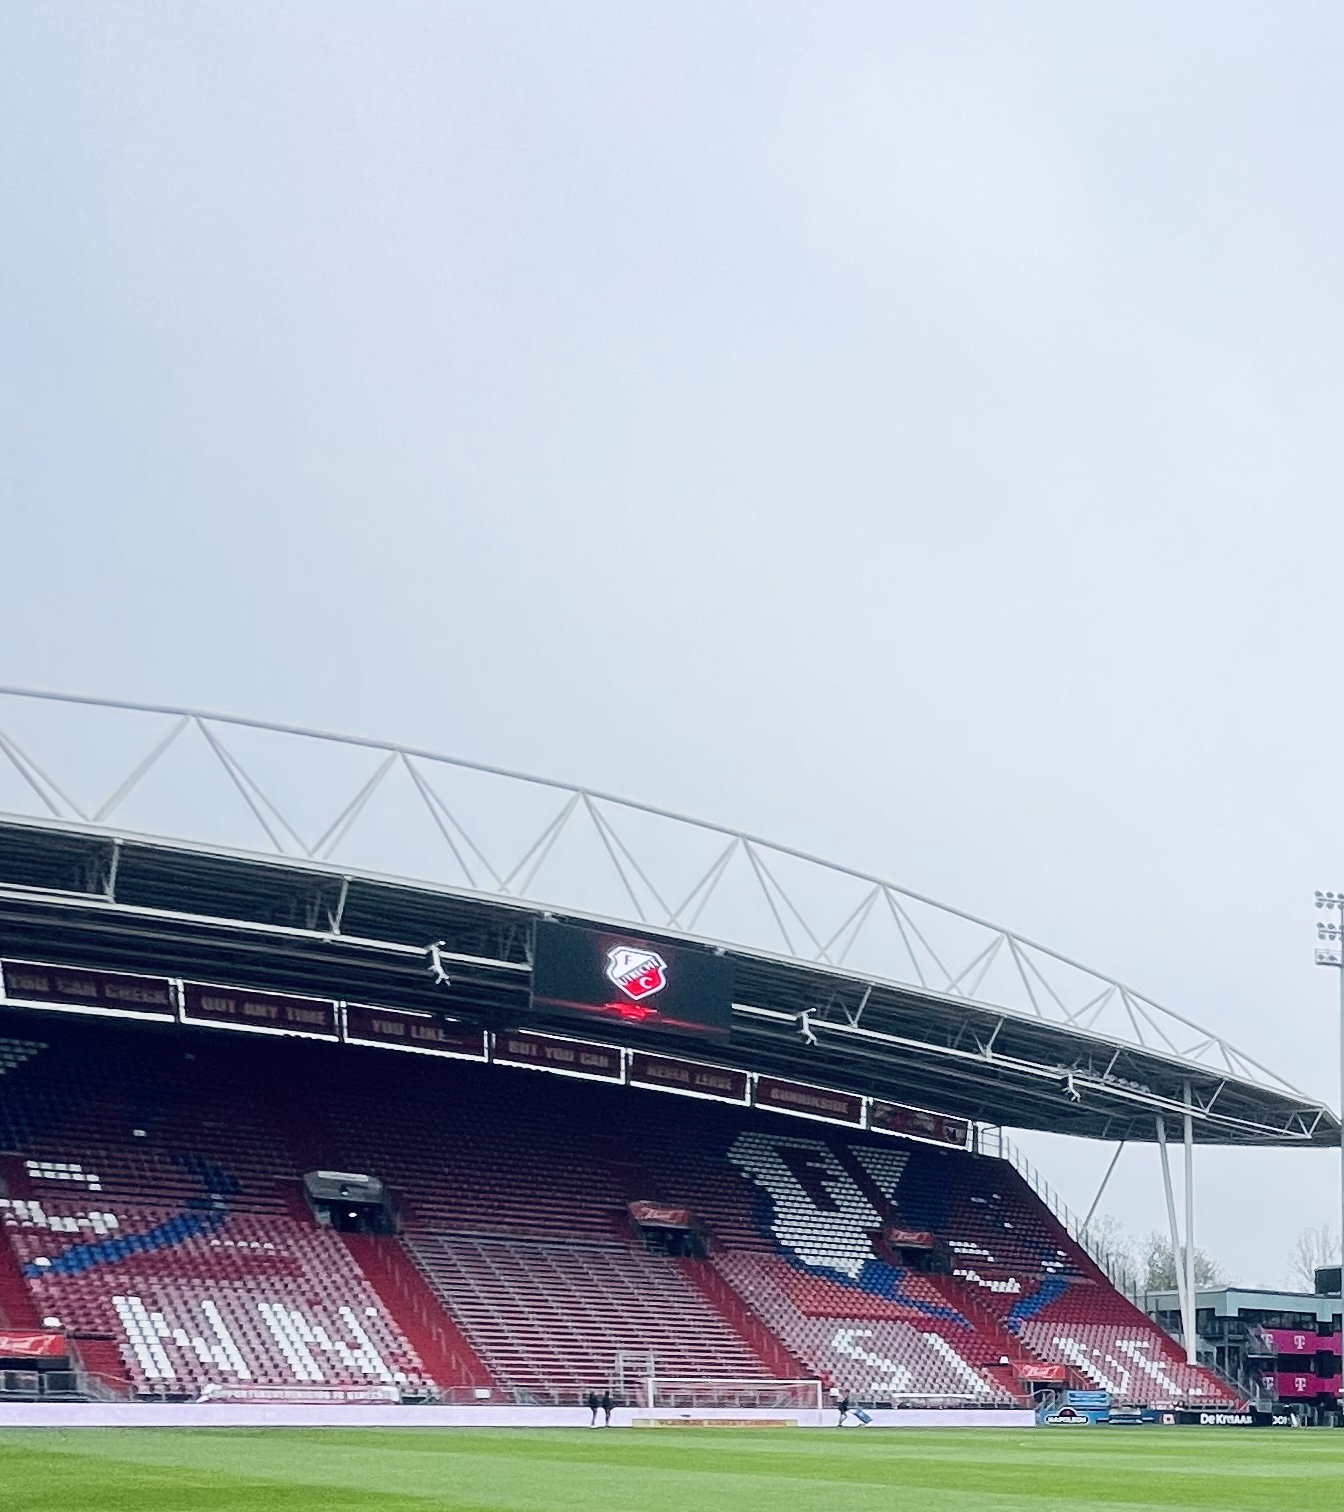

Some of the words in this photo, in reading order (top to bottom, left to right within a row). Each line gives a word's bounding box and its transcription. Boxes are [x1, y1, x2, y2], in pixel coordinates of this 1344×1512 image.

[243, 1002, 279, 1019] ANY
[285, 1006, 326, 1026] TIME
[372, 1019, 405, 1036] YOU
[544, 1047, 574, 1062] YOU
